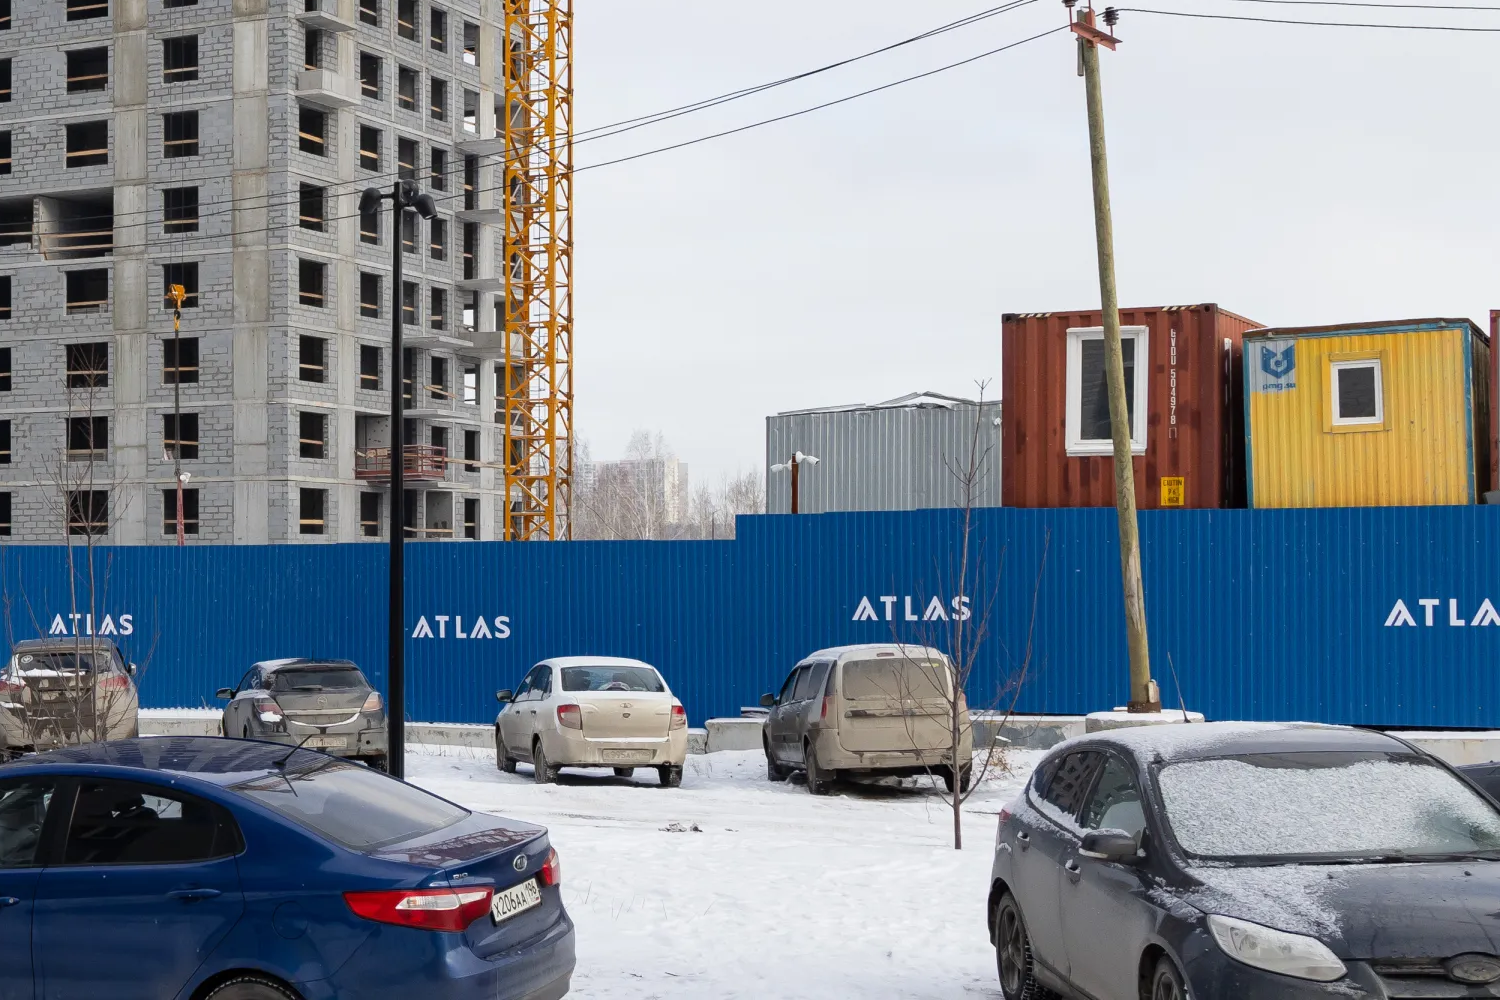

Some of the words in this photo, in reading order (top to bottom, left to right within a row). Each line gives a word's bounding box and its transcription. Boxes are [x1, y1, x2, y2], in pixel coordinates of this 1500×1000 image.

[851, 595, 971, 621] ATLAS
[48, 613, 133, 635] ATLAS
[411, 615, 511, 639] ATLAS
[453, 872, 468, 880] RIO
